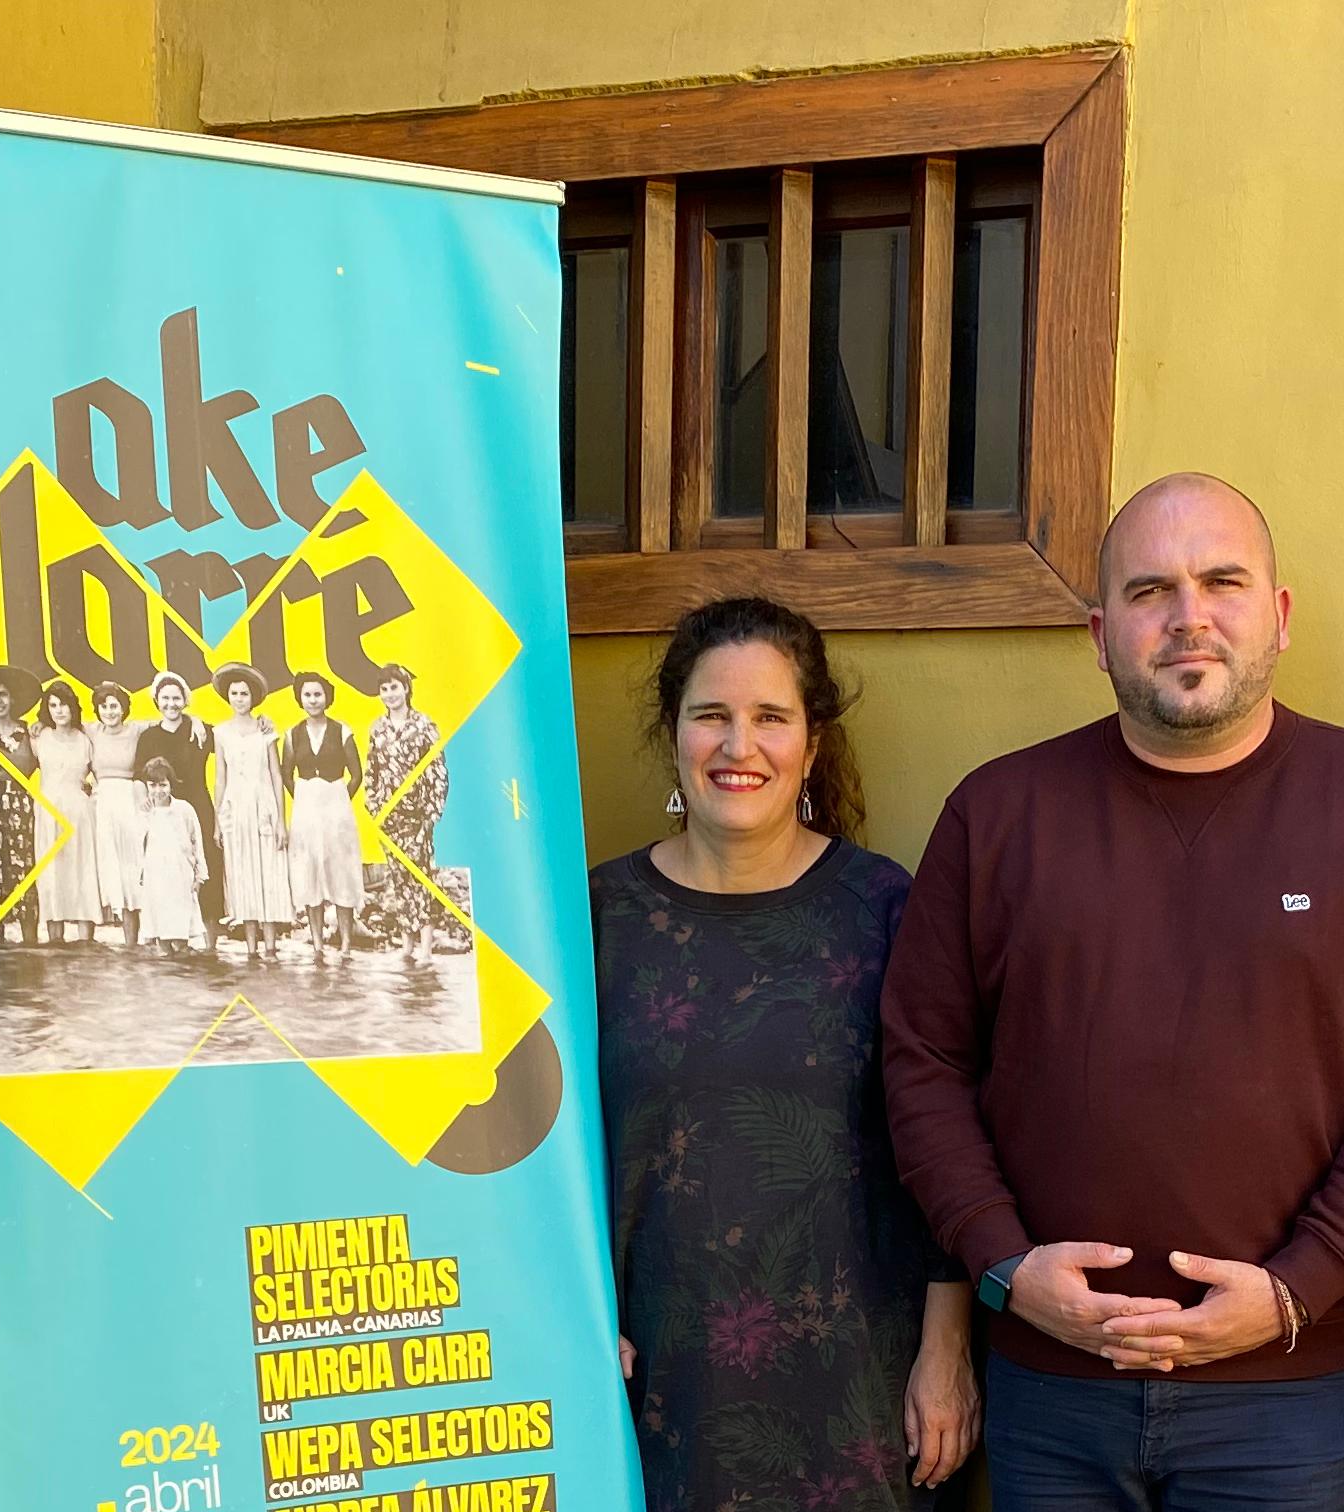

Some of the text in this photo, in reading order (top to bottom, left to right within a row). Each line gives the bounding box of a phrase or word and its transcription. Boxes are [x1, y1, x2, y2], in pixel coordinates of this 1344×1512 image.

[53, 306, 369, 538] ake
[1283, 894, 1309, 910] Lee
[250, 1215, 410, 1275] PIMIENTA
[253, 1258, 459, 1323] SELECTORAS
[257, 1325, 281, 1343] LA
[283, 1319, 343, 1341] PALMA
[353, 1309, 442, 1333] CANARIAS
[260, 1332, 490, 1402] MARCIA CARR
[264, 1404, 290, 1422] UK
[119, 1421, 221, 1468] 2024
[264, 1402, 551, 1480] WEPA SELECTORS
[268, 1473, 359, 1499] COLOMBIA
